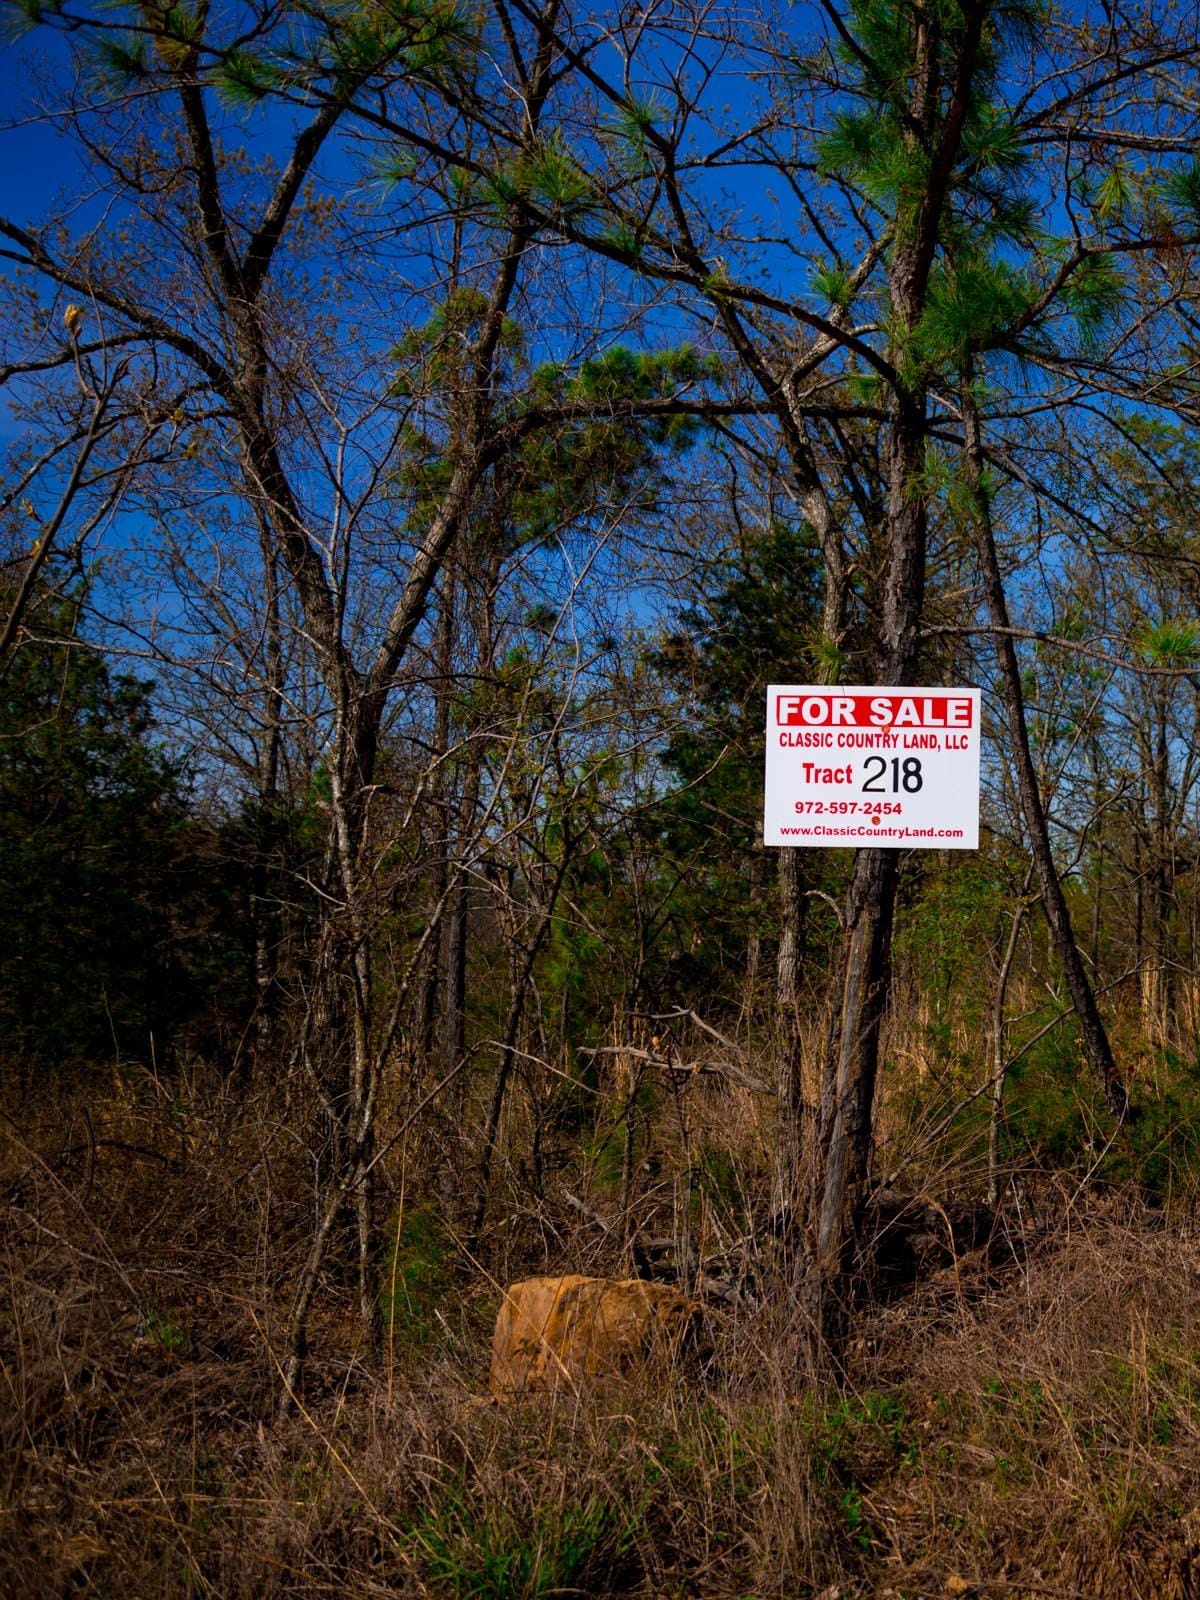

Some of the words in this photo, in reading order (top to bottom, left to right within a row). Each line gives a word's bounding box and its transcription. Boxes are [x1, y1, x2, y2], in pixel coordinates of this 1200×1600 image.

[778, 697, 856, 725] FOR
[870, 698, 970, 727] SALE
[779, 732, 833, 748] CLASSIC
[837, 733, 899, 749] COUNTRY
[903, 734, 941, 752] LAND,
[945, 734, 969, 750] LLC
[802, 762, 853, 784] Tract
[861, 755, 923, 793] 218
[795, 801, 902, 815] 972-597-2454
[780, 825, 963, 839] www.ClassicCountryLand.com
